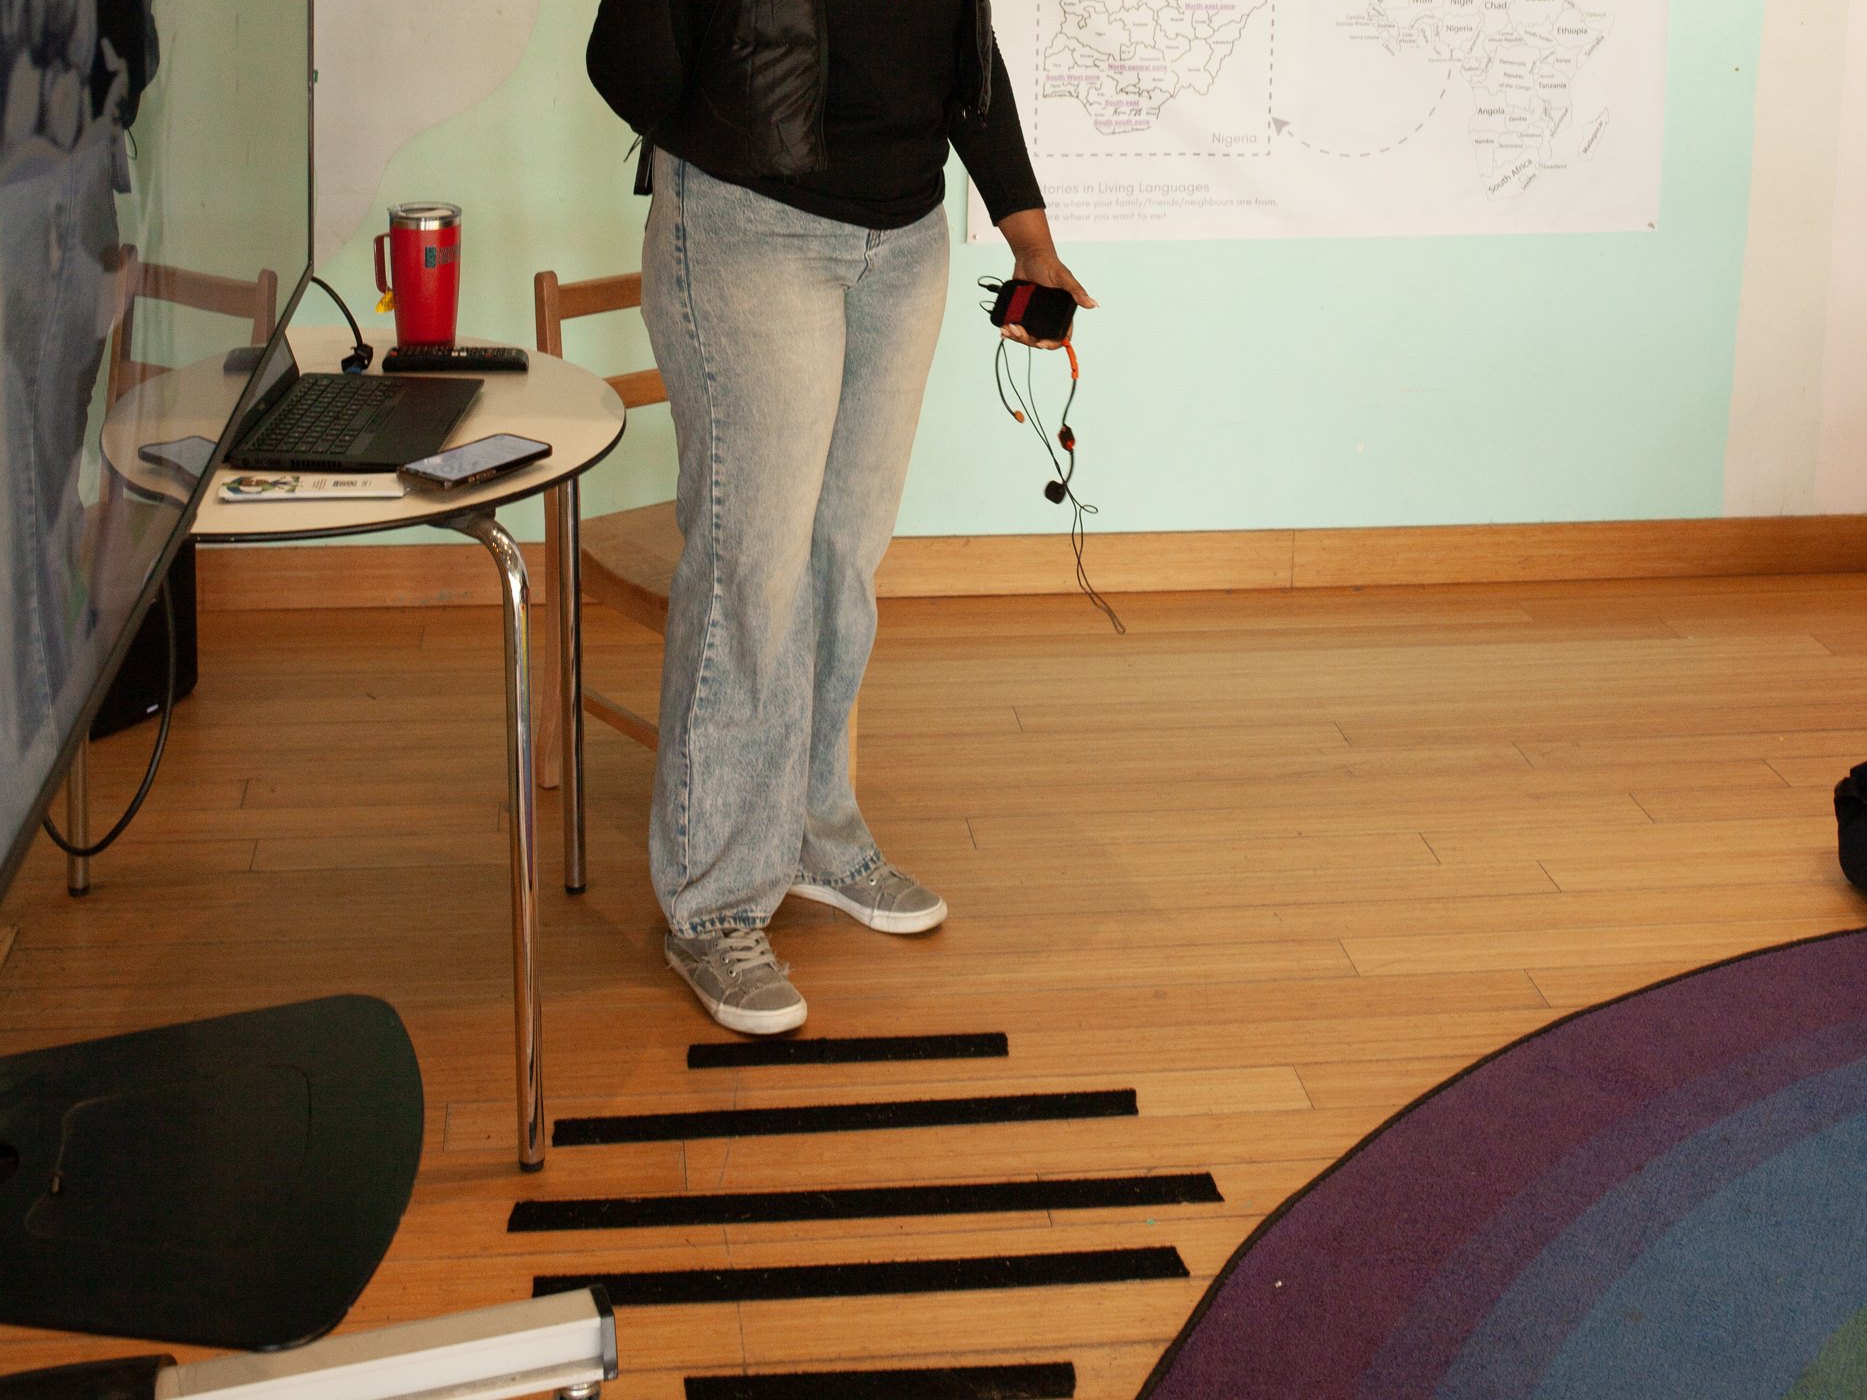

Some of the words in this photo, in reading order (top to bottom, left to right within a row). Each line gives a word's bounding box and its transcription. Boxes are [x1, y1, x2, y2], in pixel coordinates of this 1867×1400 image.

[1185, 3, 1203, 11] North
[1484, 1, 1508, 10] Chad
[1445, 24, 1473, 34] Nigeria
[1557, 26, 1588, 36] Ethiopia
[1108, 64, 1126, 72] North
[1046, 74, 1066, 82] South
[1105, 99, 1124, 107] South
[1477, 107, 1505, 117] Angola
[1094, 119, 1113, 127] South
[1212, 133, 1257, 147] Nigeria
[1488, 174, 1512, 194] South
[1511, 158, 1533, 177] Africa
[1040, 182, 1079, 194] tories
[1083, 183, 1094, 193] in
[1098, 181, 1134, 197] Living
[1139, 181, 1210, 197] Languages
[1063, 199, 1090, 208] where
[1094, 201, 1112, 210] your
[1063, 212, 1090, 221] where
[1094, 213, 1109, 223] you
[1111, 212, 1134, 220] want
[1137, 212, 1146, 220] to
